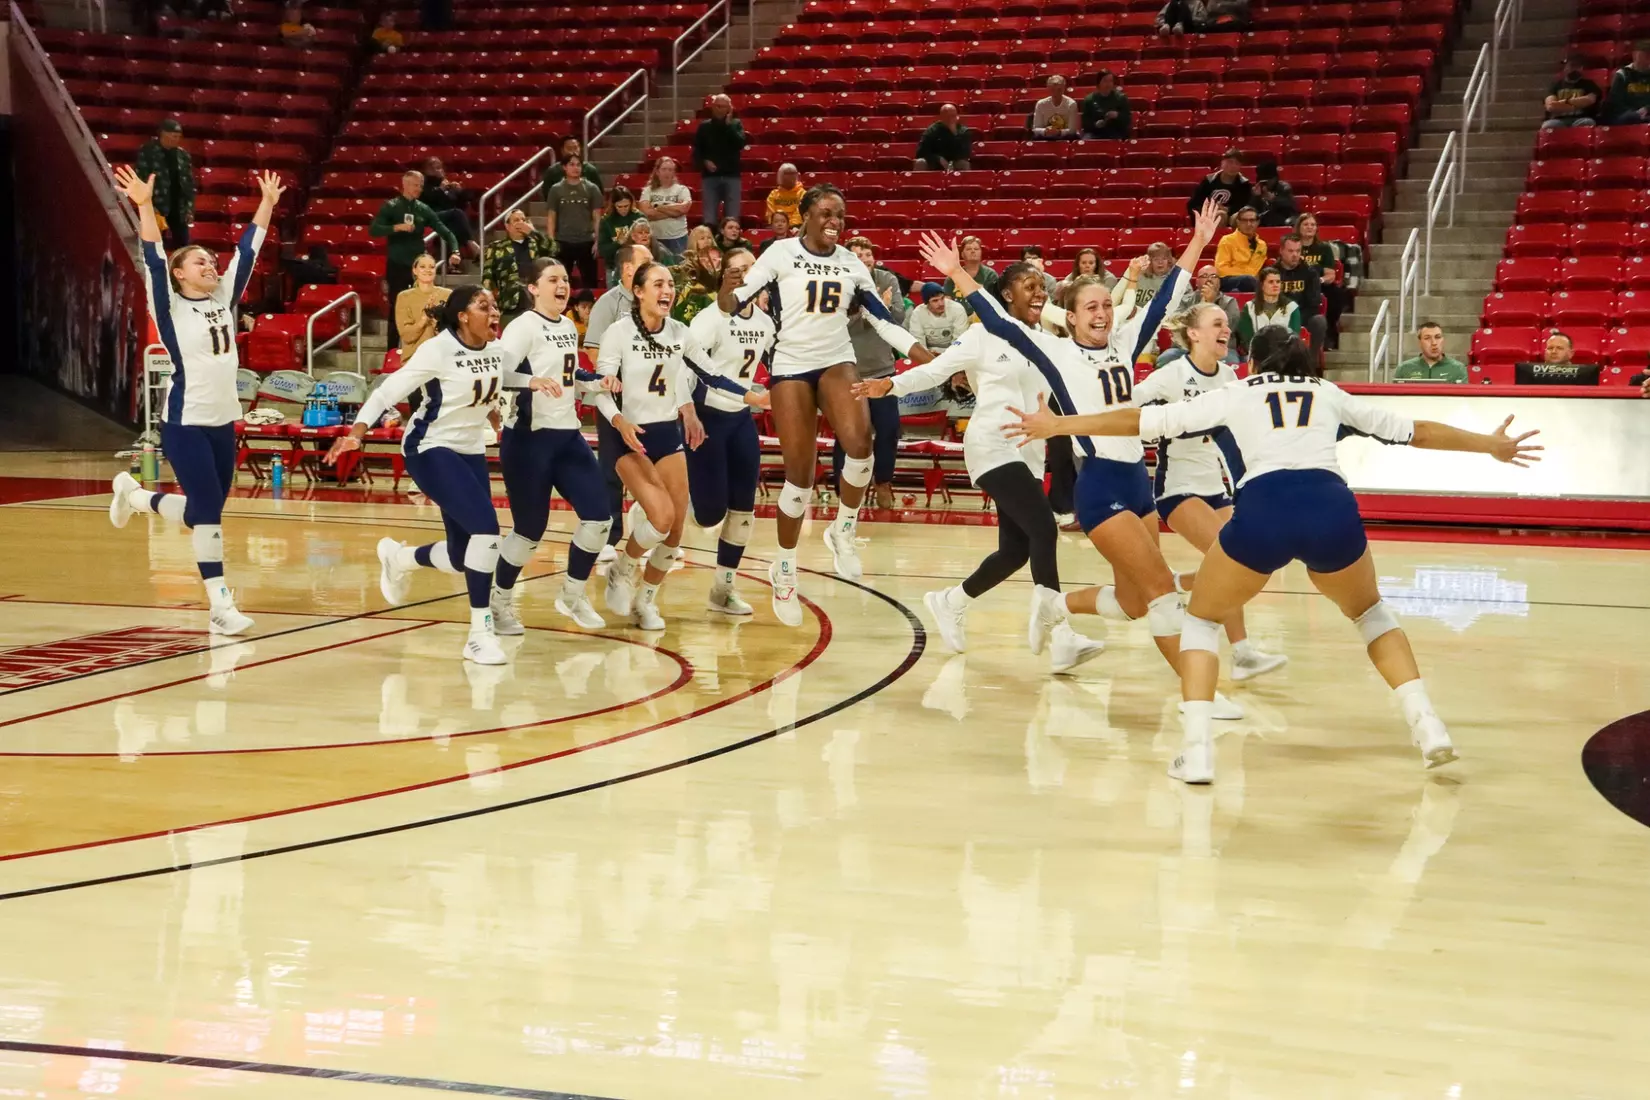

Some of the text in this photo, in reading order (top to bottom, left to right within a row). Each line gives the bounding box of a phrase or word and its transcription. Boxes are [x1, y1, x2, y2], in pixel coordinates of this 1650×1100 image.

[793, 262, 851, 273] KANSAS
[805, 280, 842, 314] 16
[209, 325, 230, 355] 11
[471, 364, 498, 374] CITY
[562, 353, 576, 387] 9
[738, 349, 755, 378] 2
[325, 383, 356, 393] UMMIT
[467, 376, 499, 407] 14
[648, 363, 666, 397] 4
[1097, 365, 1132, 406] 10
[898, 395, 934, 404] SUMMIT
[1264, 391, 1314, 429] 17
